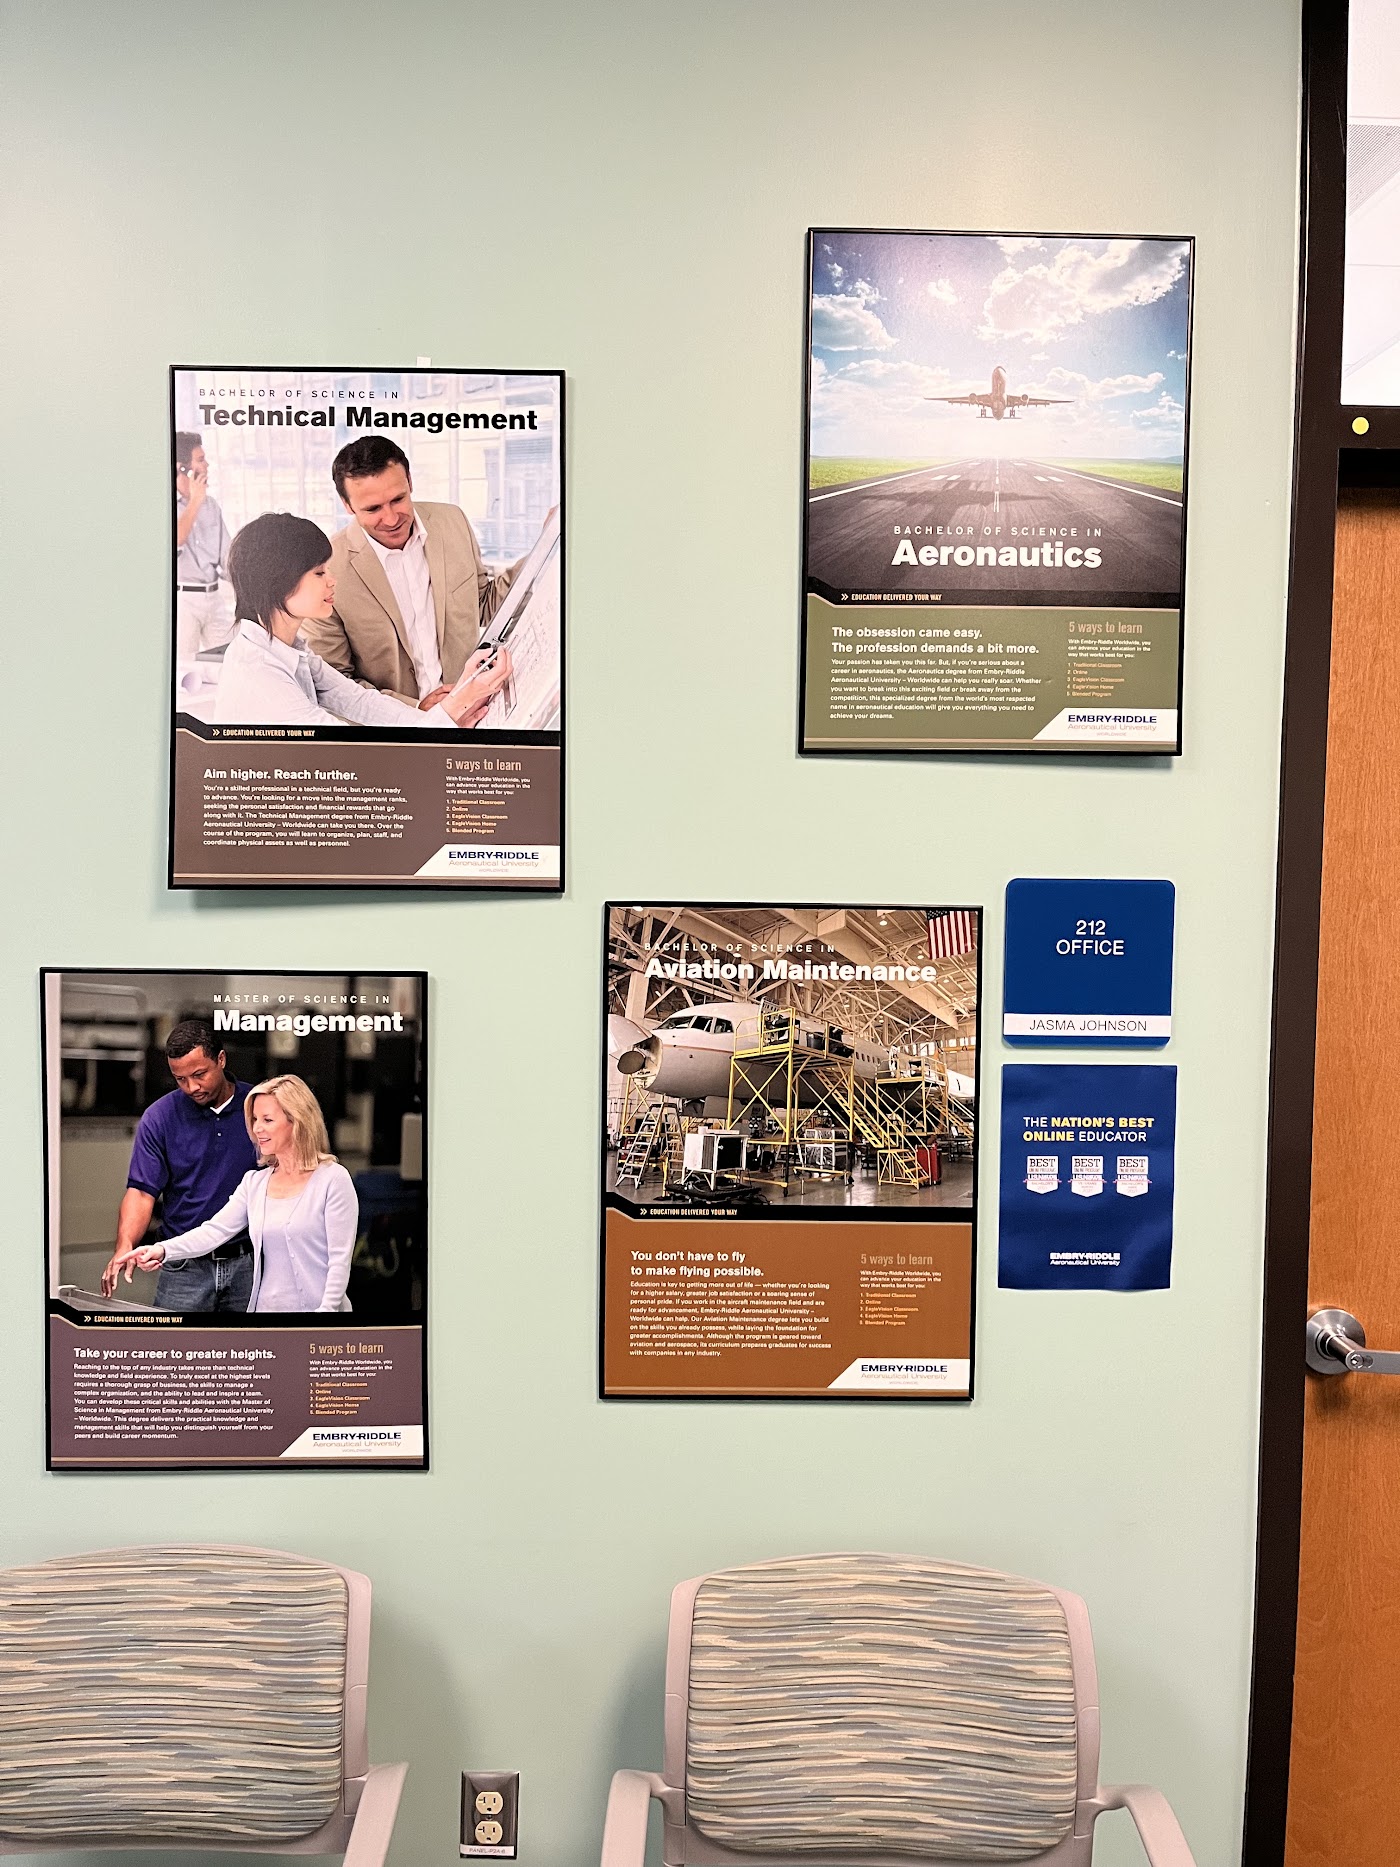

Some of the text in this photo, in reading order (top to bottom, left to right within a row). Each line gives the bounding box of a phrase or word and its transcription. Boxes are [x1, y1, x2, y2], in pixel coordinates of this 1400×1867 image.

[200, 389, 398, 399] BACHELOR OF SCIENCE IN
[199, 404, 537, 434] Technical Management
[894, 526, 1101, 536] BACHELOR OF SCIENCE IN
[891, 539, 1102, 568] Aeronautics
[832, 627, 982, 639] The obsession came easy.
[1069, 621, 1142, 635] 5 ways to learn
[832, 642, 1039, 654] The profession demands a bit more.
[1068, 715, 1157, 723] EMBRY-RIDDLE
[446, 758, 521, 772] 5 ways to learn
[203, 768, 358, 781] Aim higher. Reach further.
[448, 851, 539, 859] EMBRY-RIDDLE
[1076, 920, 1106, 935] 212
[644, 943, 835, 952] BACHELOR OF SCIENCE IN
[1056, 939, 1124, 955] OFFICE
[644, 958, 937, 982] Aviation Maintenance
[214, 995, 269, 1003] MASTER
[278, 995, 295, 1003] OF
[304, 995, 367, 1003] SCIENCE
[213, 1009, 403, 1036] Management
[1030, 1020, 1147, 1032] JASMA JOHNSON
[1023, 1117, 1154, 1128] THE NATION'S BEST
[1023, 1131, 1146, 1142] ONLINE EDUCATOR
[1030, 1158, 1056, 1167] BEST
[1074, 1158, 1100, 1167] BEST
[1119, 1159, 1145, 1168] BEST
[681, 1208, 710, 1216] DELIVERED
[631, 1251, 746, 1263] You don't have to fly
[861, 1253, 933, 1267] 5 ways to learn
[1050, 1252, 1120, 1260] EMBRY-RIDDLE
[631, 1266, 764, 1277] to make flying possible.
[73, 1348, 100, 1358] Take
[103, 1350, 129, 1360] your
[170, 1349, 183, 1359] to
[186, 1350, 228, 1360] greater
[230, 1349, 276, 1360] heights.
[310, 1342, 384, 1356] 5 ways to learn
[861, 1364, 948, 1372] EMBRY-RIDDLE
[313, 1432, 401, 1440] EMBRY-RIDDLE
